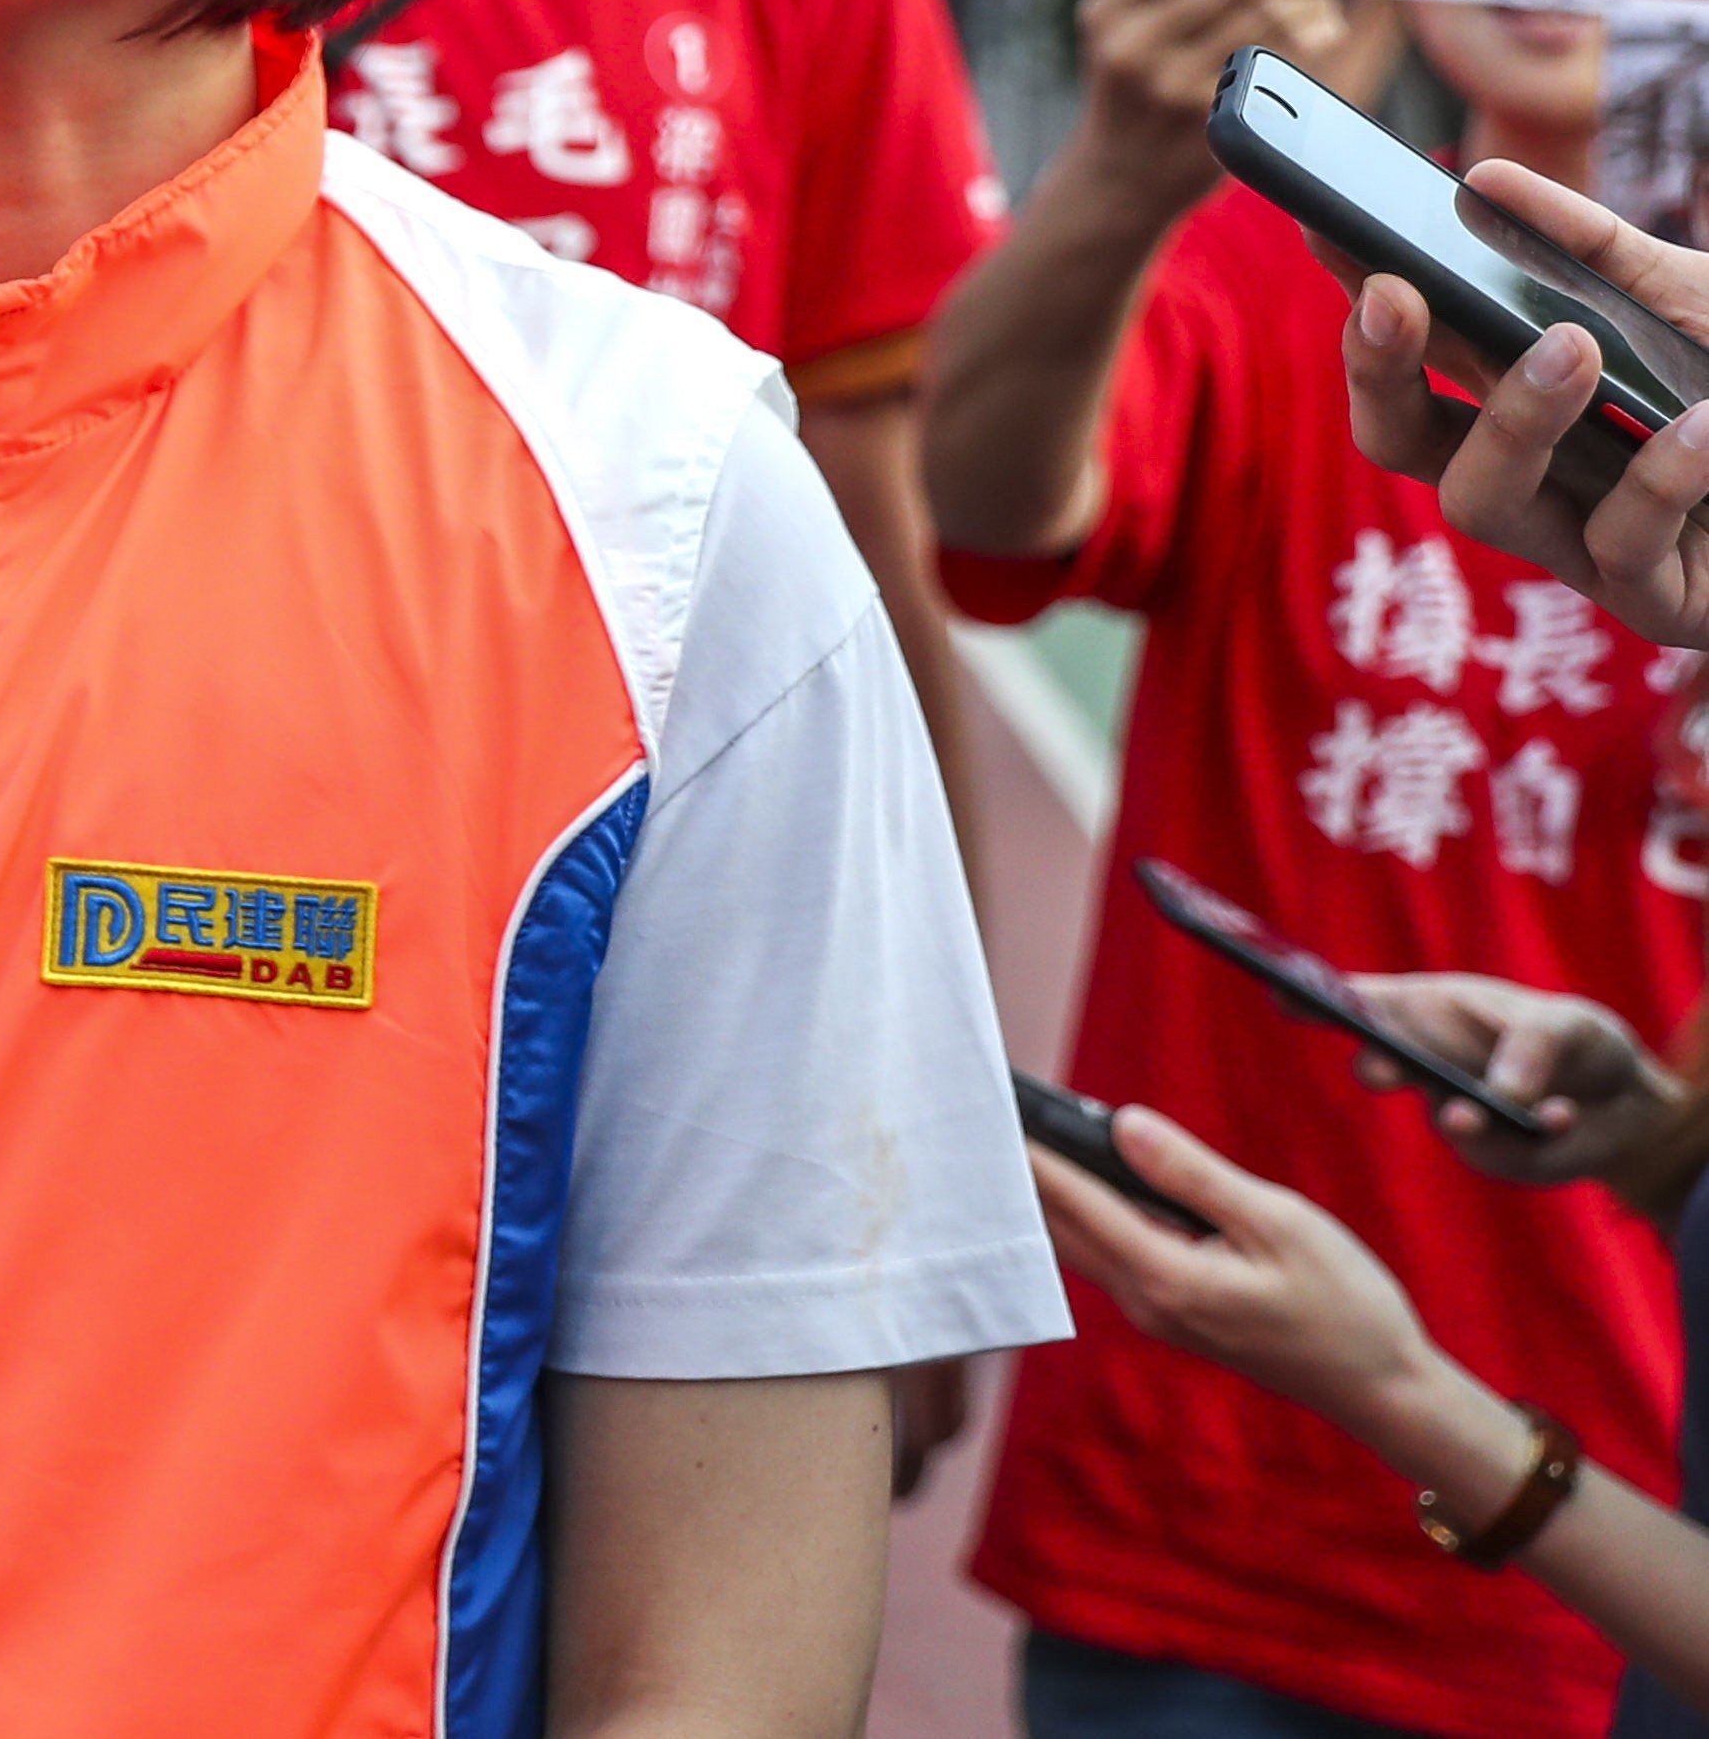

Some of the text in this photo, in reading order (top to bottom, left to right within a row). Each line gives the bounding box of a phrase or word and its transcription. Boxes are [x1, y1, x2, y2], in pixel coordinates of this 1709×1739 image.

[155, 882, 359, 962] 民建聯
[250, 957, 355, 993] DAB
